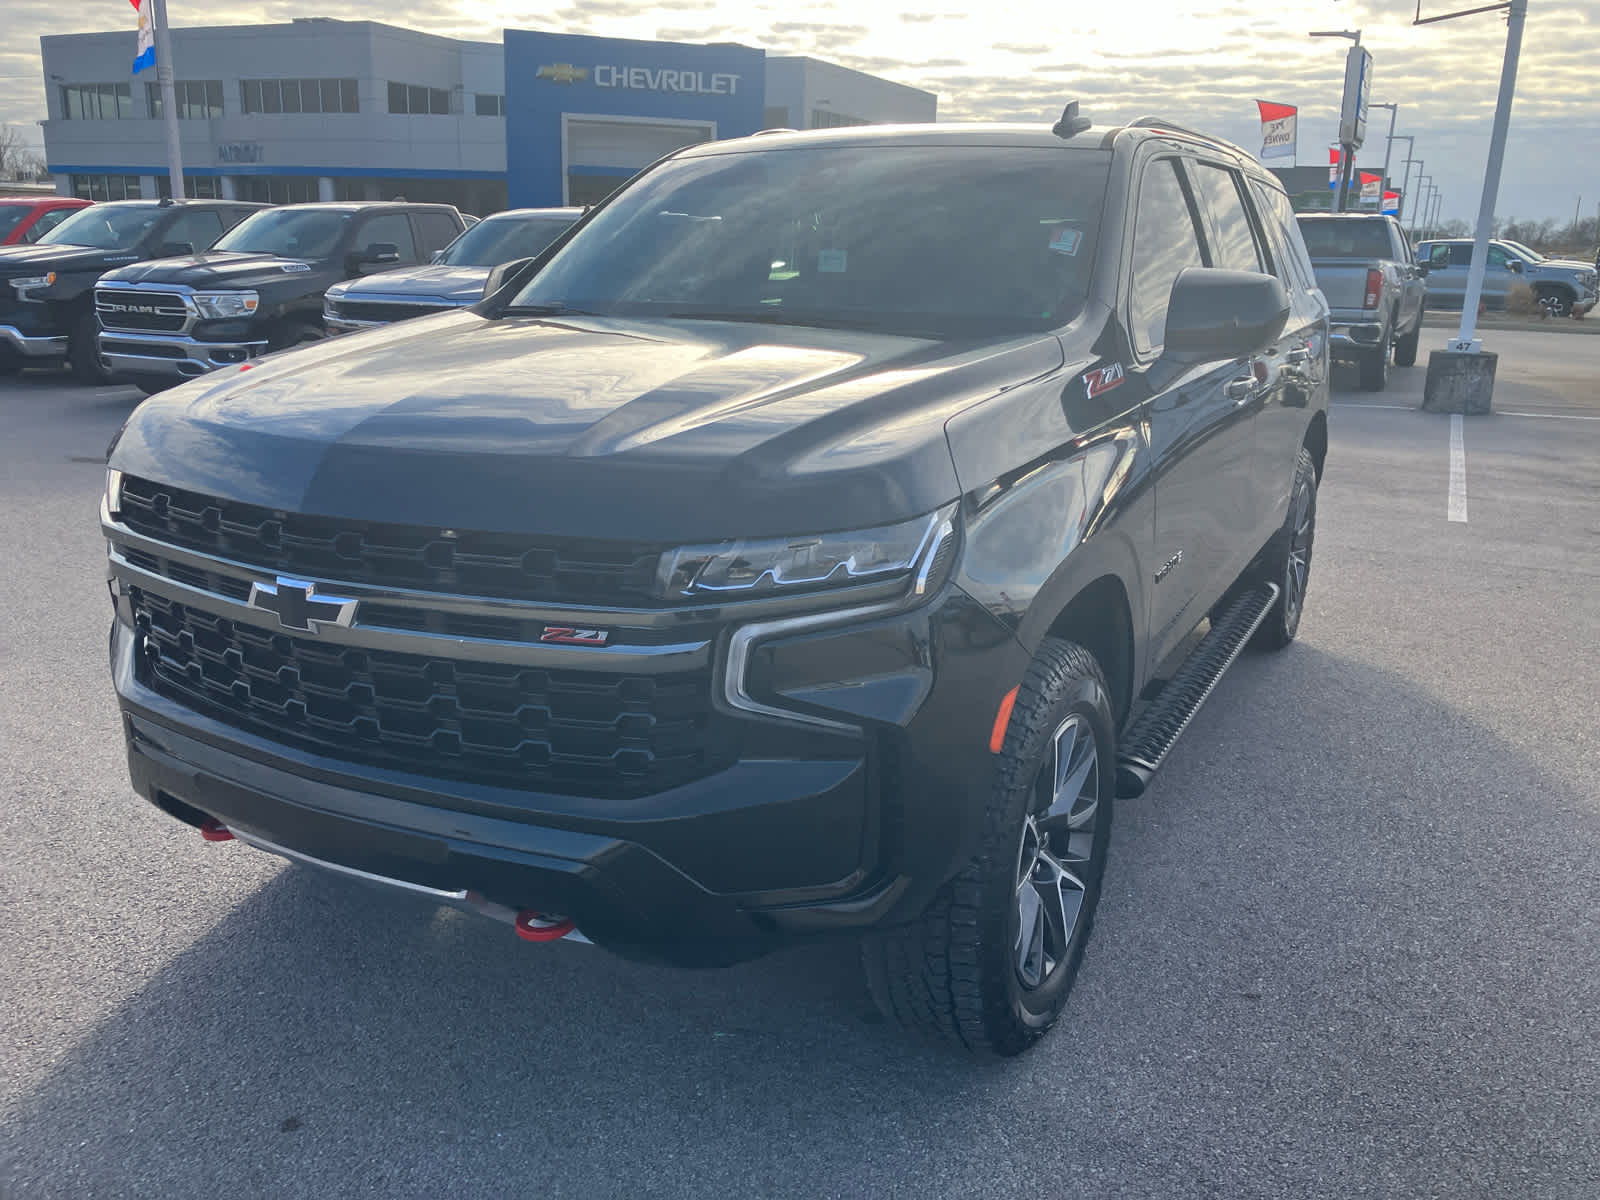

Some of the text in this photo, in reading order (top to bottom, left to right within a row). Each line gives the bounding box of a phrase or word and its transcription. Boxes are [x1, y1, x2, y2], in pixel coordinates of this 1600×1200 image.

[594, 65, 741, 95] CHEVROLET
[1456, 342, 1473, 352] 47
[1081, 362, 1125, 400] Z71
[540, 626, 609, 644] Z71
